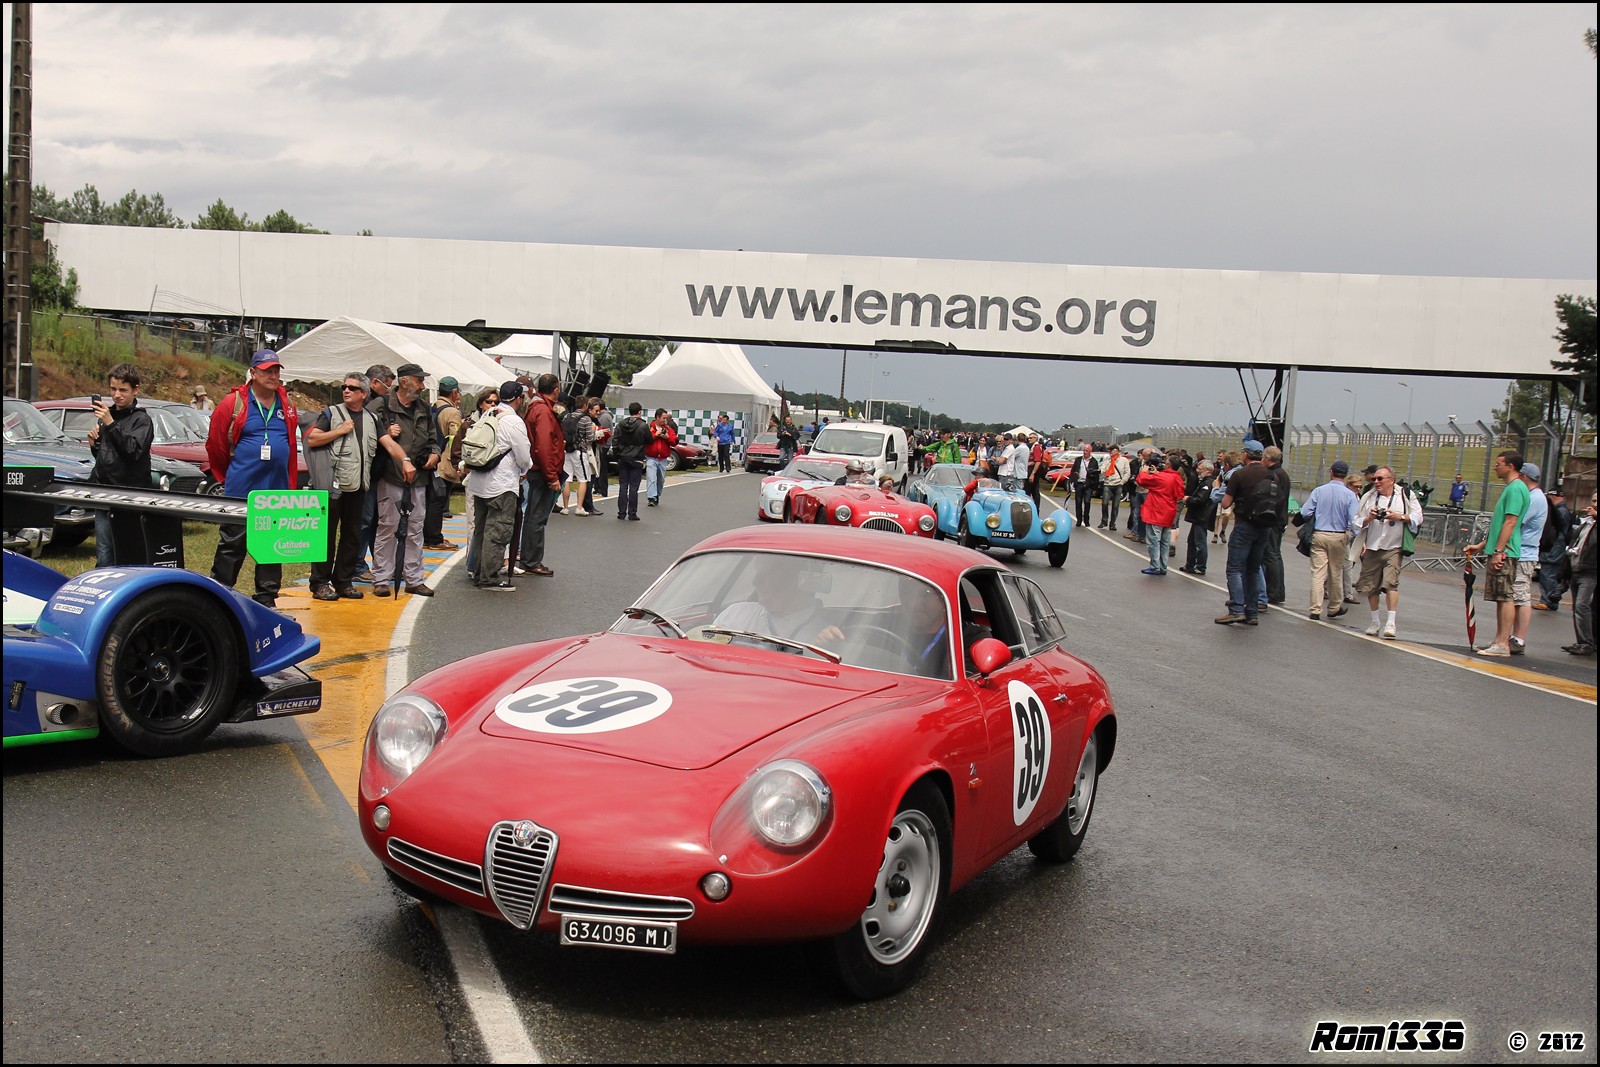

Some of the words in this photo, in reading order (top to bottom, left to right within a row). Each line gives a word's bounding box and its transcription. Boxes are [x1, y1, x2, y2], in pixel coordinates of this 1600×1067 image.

[685, 284, 1157, 347] www.lemans.org
[254, 495, 320, 509] SCANIA
[254, 516, 271, 530] ESEO
[278, 540, 310, 549] Latitudes
[104, 636, 121, 715] MICHELIN
[274, 698, 319, 711] MICHELIN
[507, 679, 658, 728] 39
[1014, 697, 1046, 809] 39
[569, 921, 636, 944] 634096
